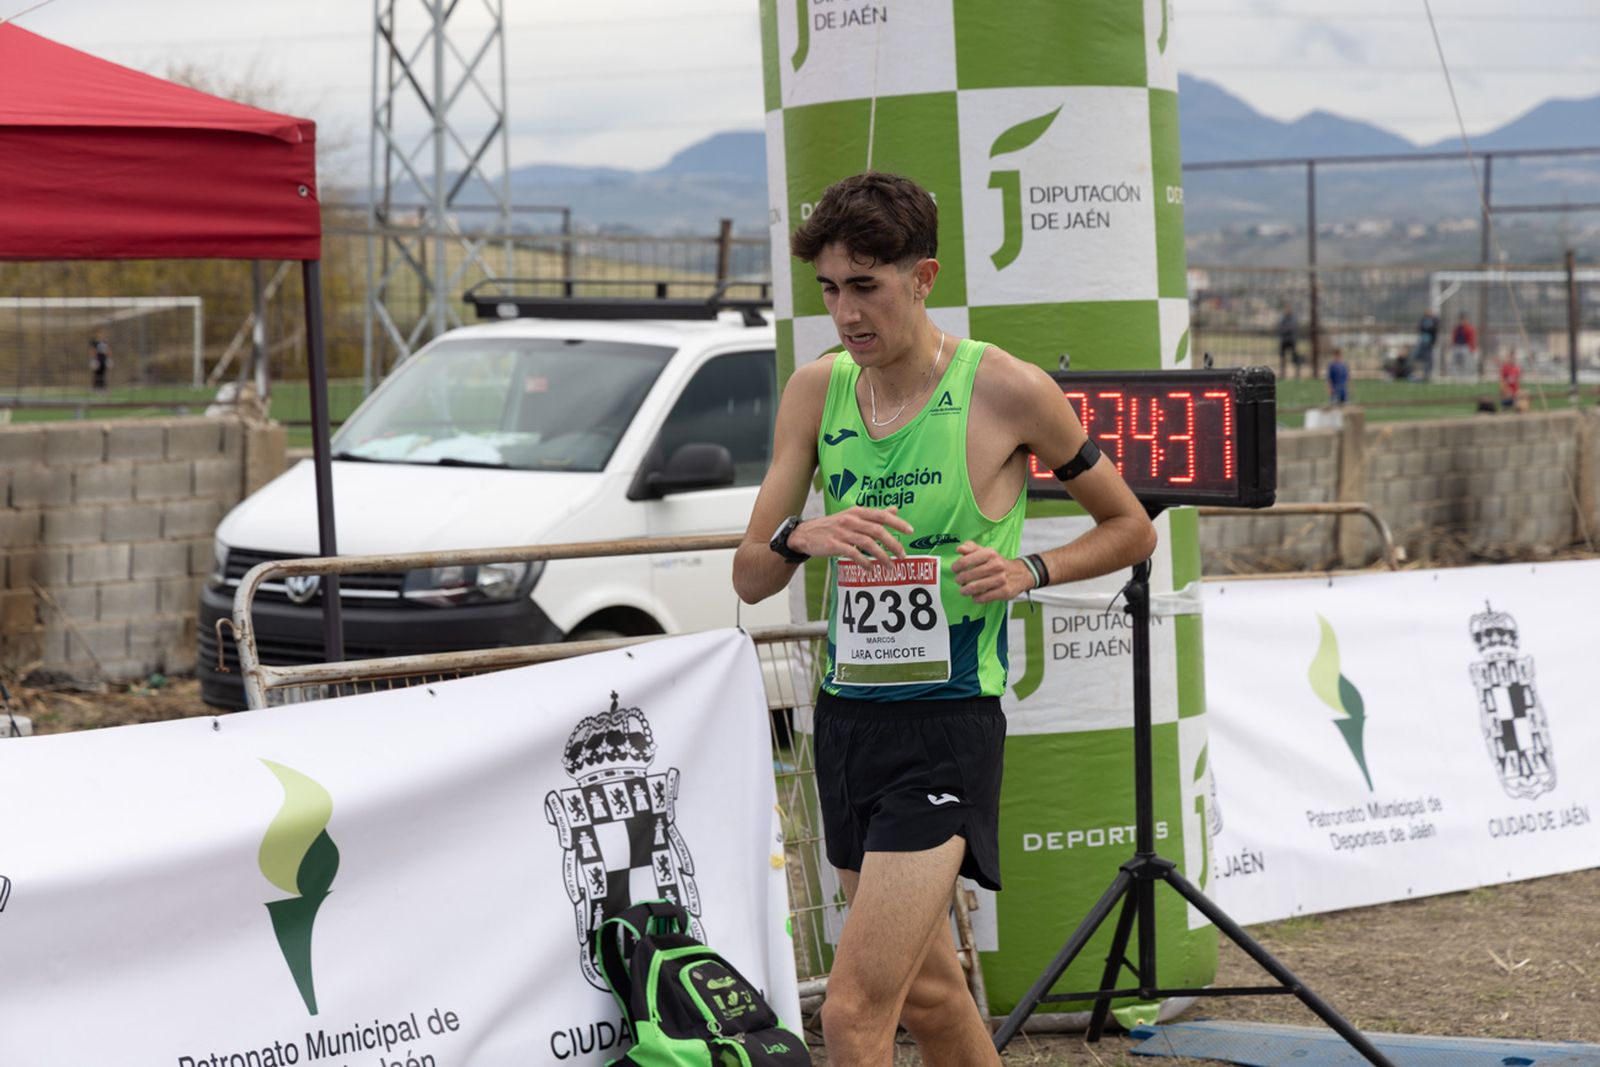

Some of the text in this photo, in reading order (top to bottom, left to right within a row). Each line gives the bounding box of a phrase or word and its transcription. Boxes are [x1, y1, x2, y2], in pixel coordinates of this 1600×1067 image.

[814, 4, 888, 31] DE JAÉN
[1029, 181, 1141, 204] DIPUTACIÓN
[1031, 207, 1110, 231] DE JAÉN
[861, 467, 942, 491] Fundación
[856, 487, 915, 510] Unicaja
[842, 587, 938, 634] 4238
[1052, 611, 1162, 634] DIPUTACN
[851, 647, 926, 660] LARA CHICOTE
[1053, 636, 1132, 660] DE JAÉN
[1306, 795, 1443, 828] Patronato Municipal de
[1488, 811, 1537, 838] CIUDAD
[1538, 809, 1557, 831] DE
[1023, 821, 1169, 852] DEPORTS
[1329, 827, 1388, 852] Deportes
[1389, 823, 1405, 843] de
[1223, 846, 1265, 878] JAÉN
[305, 1012, 421, 1061] Municipal
[427, 1008, 460, 1035] de
[550, 1016, 634, 1061] CIUDA
